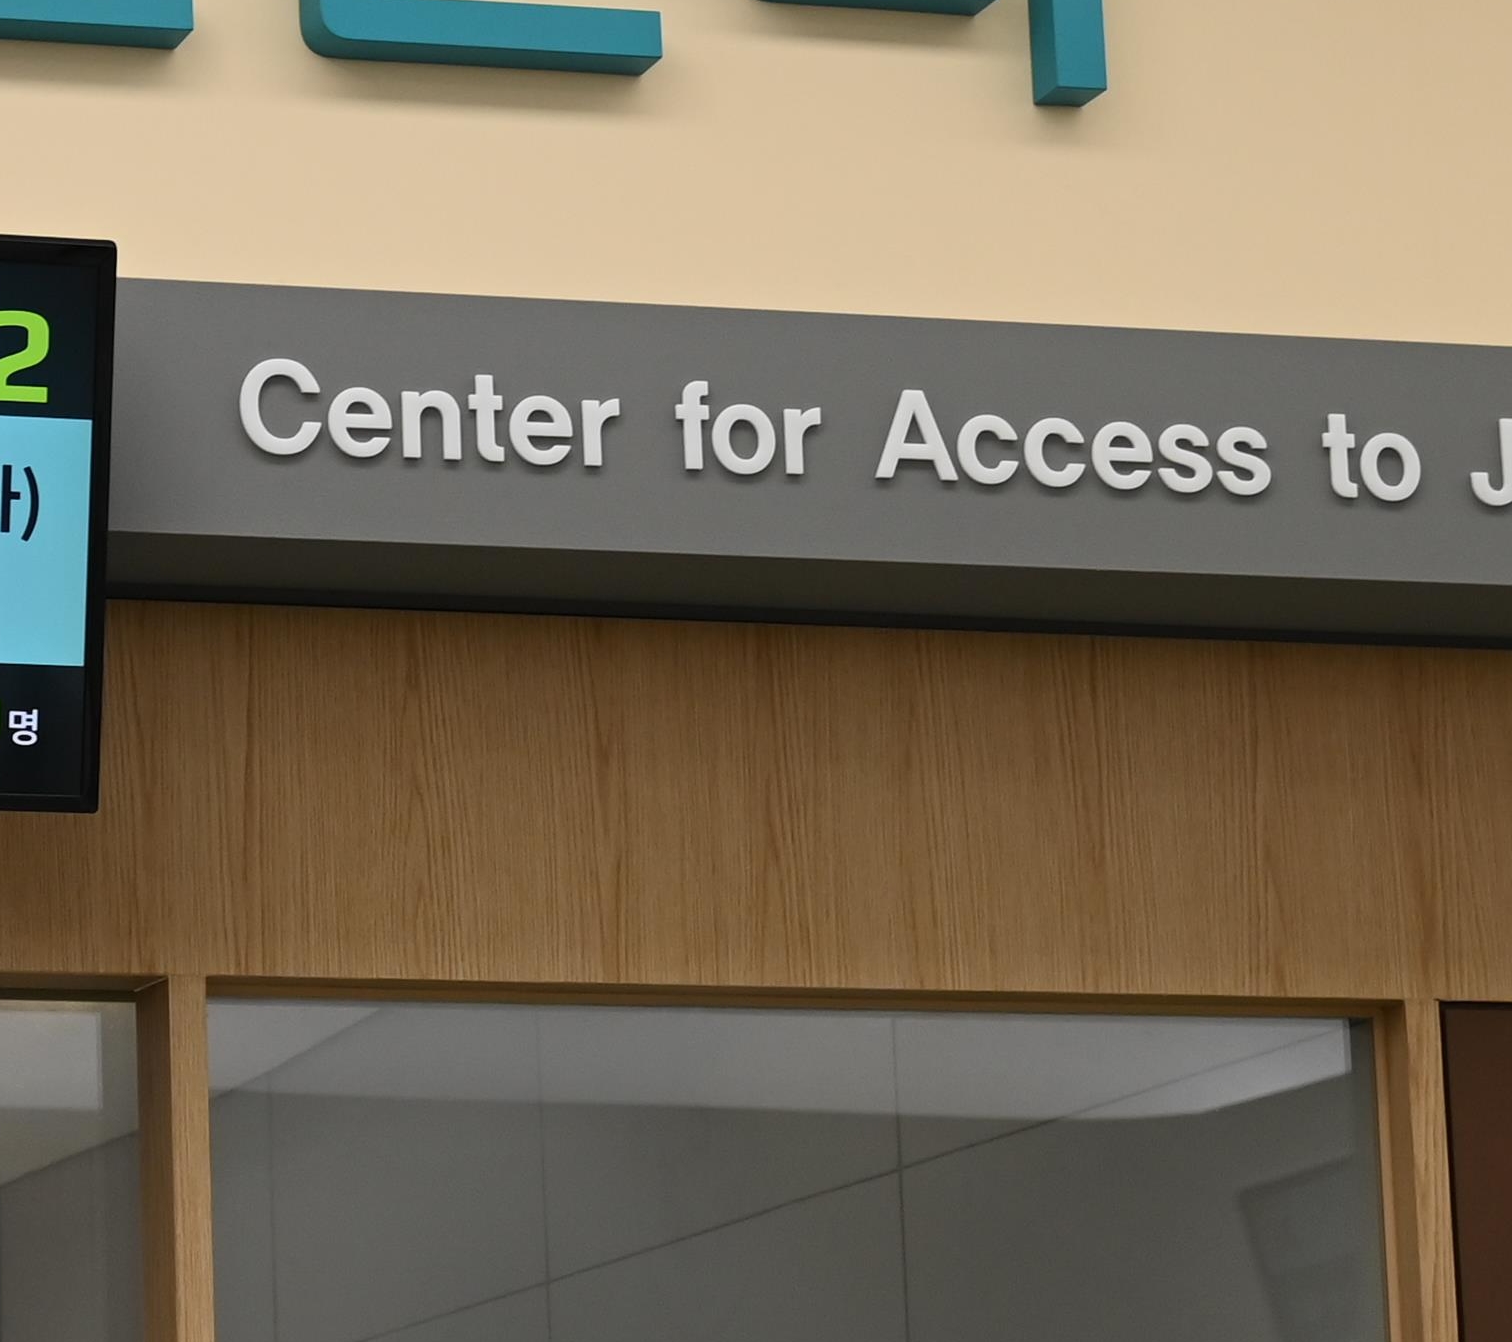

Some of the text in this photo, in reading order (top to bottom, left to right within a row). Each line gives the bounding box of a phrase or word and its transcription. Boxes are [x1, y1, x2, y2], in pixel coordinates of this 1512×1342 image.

[239, 358, 621, 468] Center
[675, 379, 822, 477] for
[875, 388, 1272, 497] Access
[1322, 413, 1422, 502] to
[8, 708, 39, 745] 명
